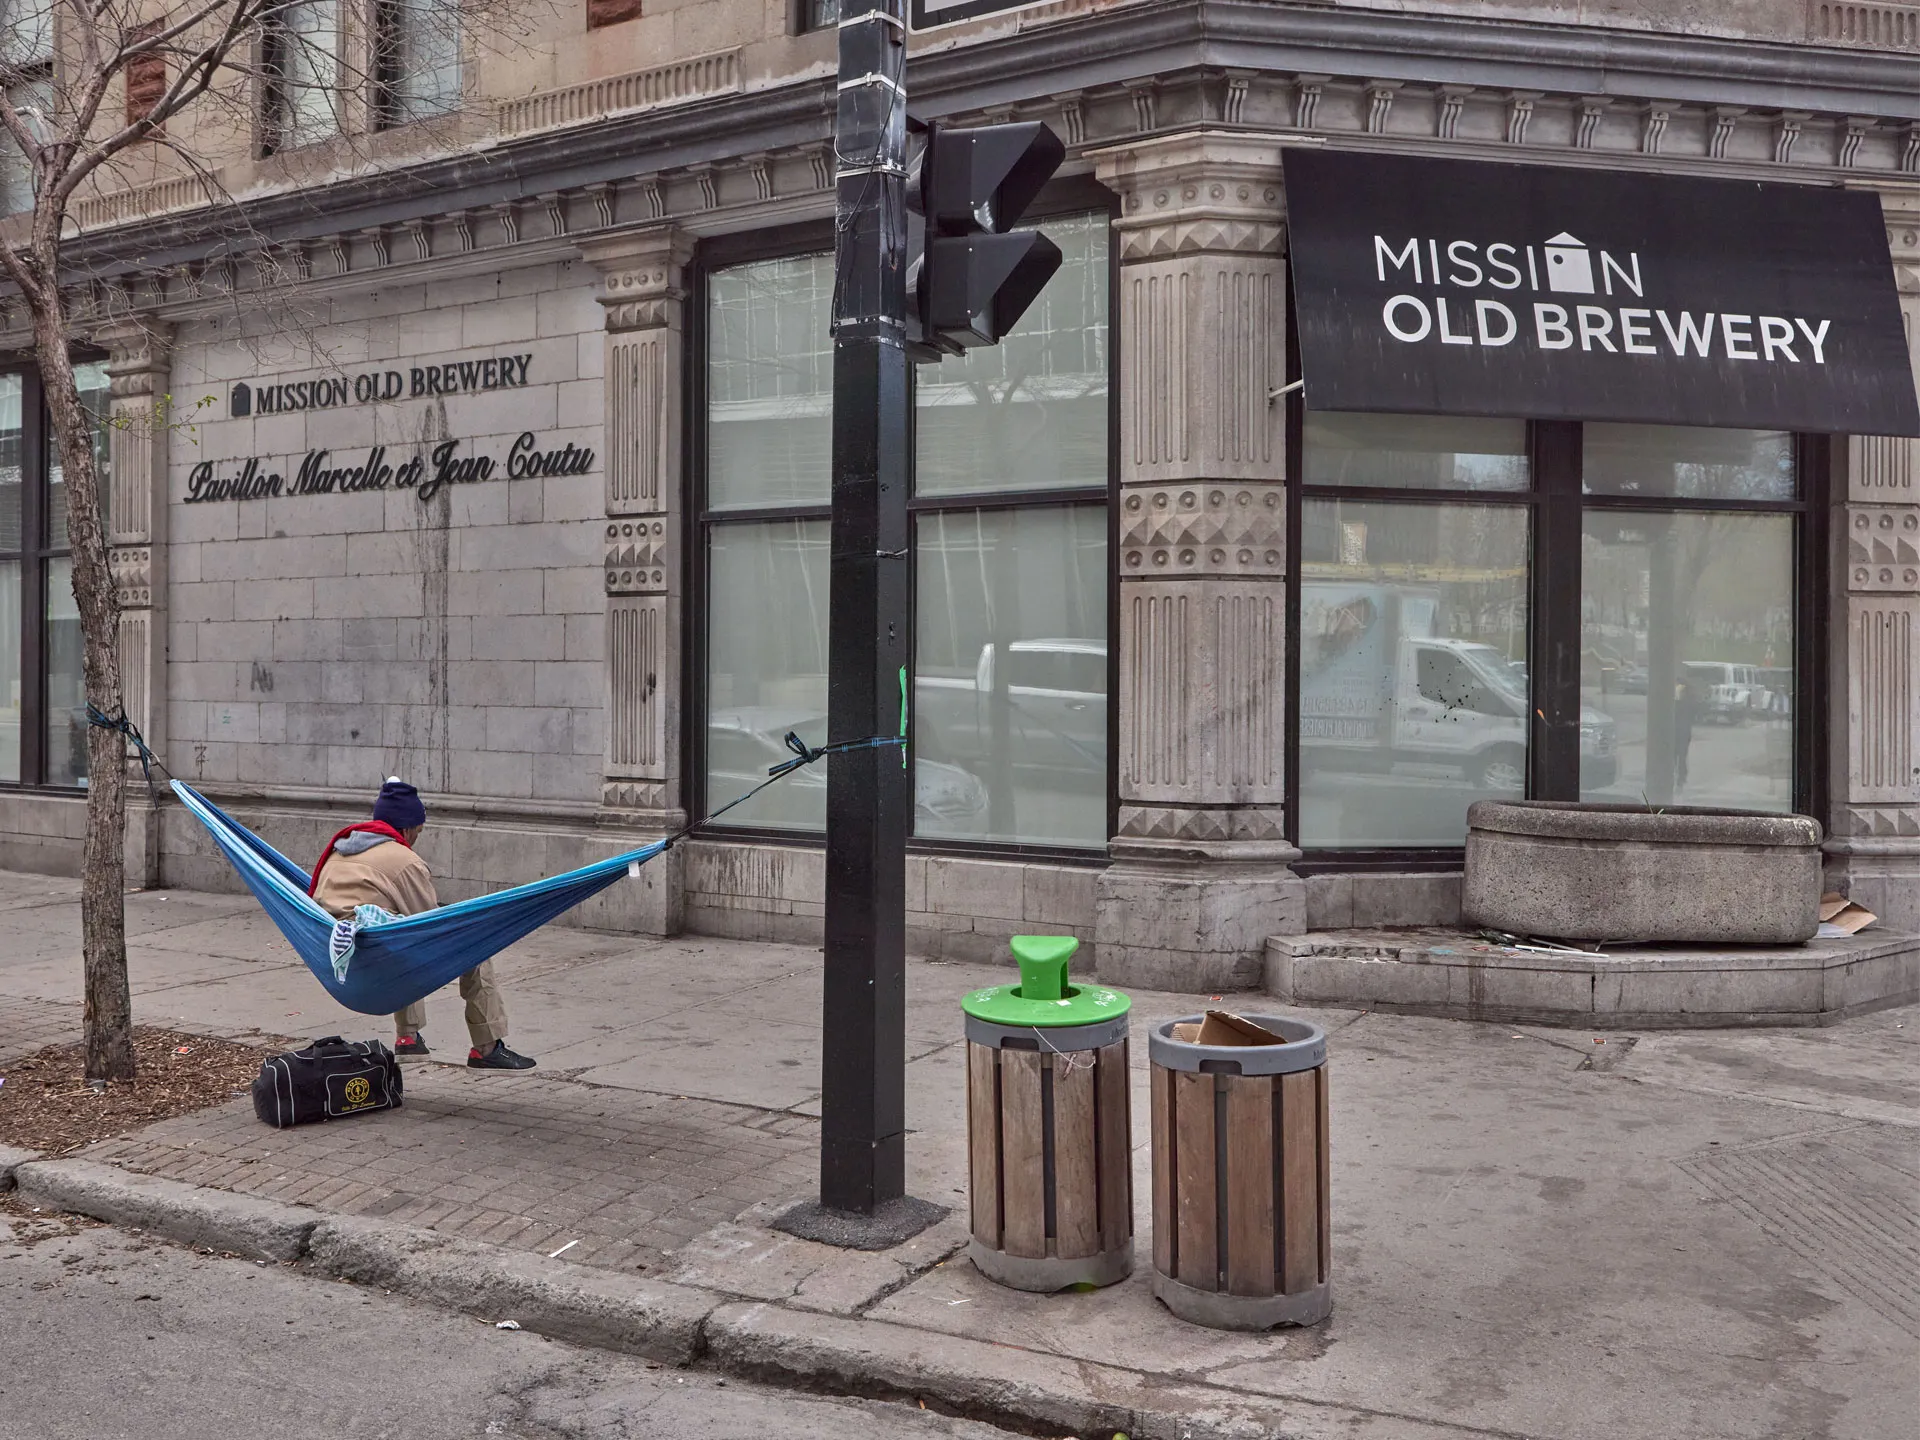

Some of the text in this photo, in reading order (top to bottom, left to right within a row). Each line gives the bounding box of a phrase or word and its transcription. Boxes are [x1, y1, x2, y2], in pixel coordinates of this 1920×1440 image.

[1373, 232, 1644, 298] MISSIN
[1382, 294, 1831, 364] OLD BREWERY
[256, 354, 532, 414] MISSION OLD BREWERY
[183, 431, 595, 504] Pavillon Marcelle et Jean Coutu
